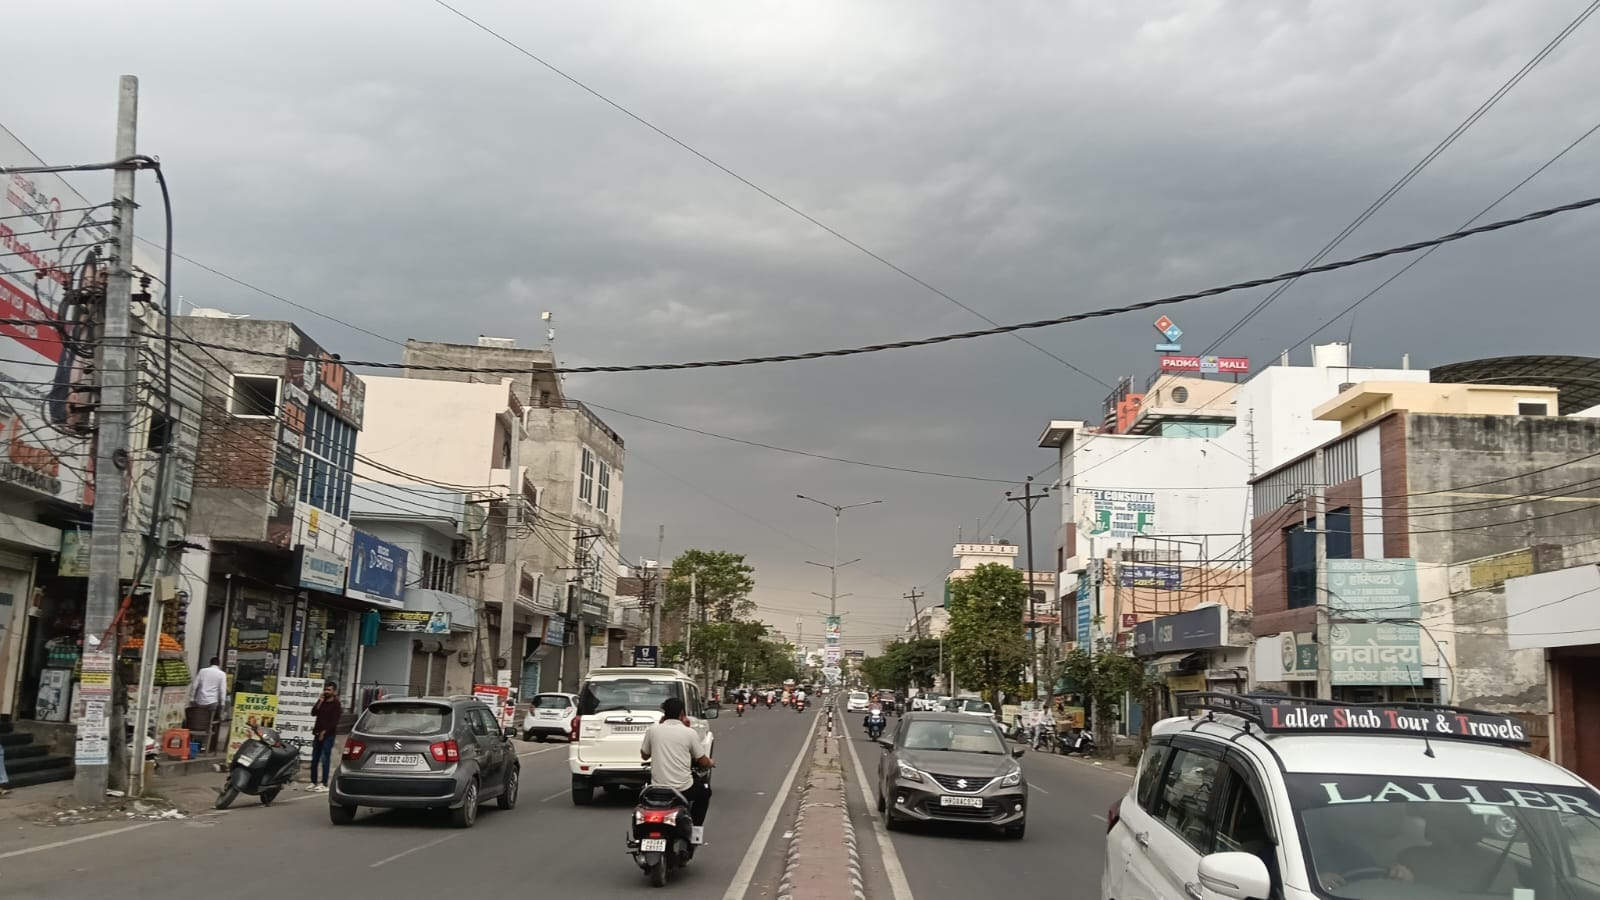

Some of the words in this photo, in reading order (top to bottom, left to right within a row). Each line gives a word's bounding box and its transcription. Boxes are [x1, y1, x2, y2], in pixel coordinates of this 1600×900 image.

[1162, 359, 1199, 368] PADMA
[1219, 360, 1248, 369] MALL
[1331, 637, 1419, 664] नवोदय
[1271, 707, 1329, 729] Laller
[1333, 708, 1382, 729] Shab
[1384, 710, 1430, 732] Tour
[1435, 714, 1453, 734] &
[1455, 715, 1525, 741] Travels
[1320, 781, 1600, 818] LALLER
